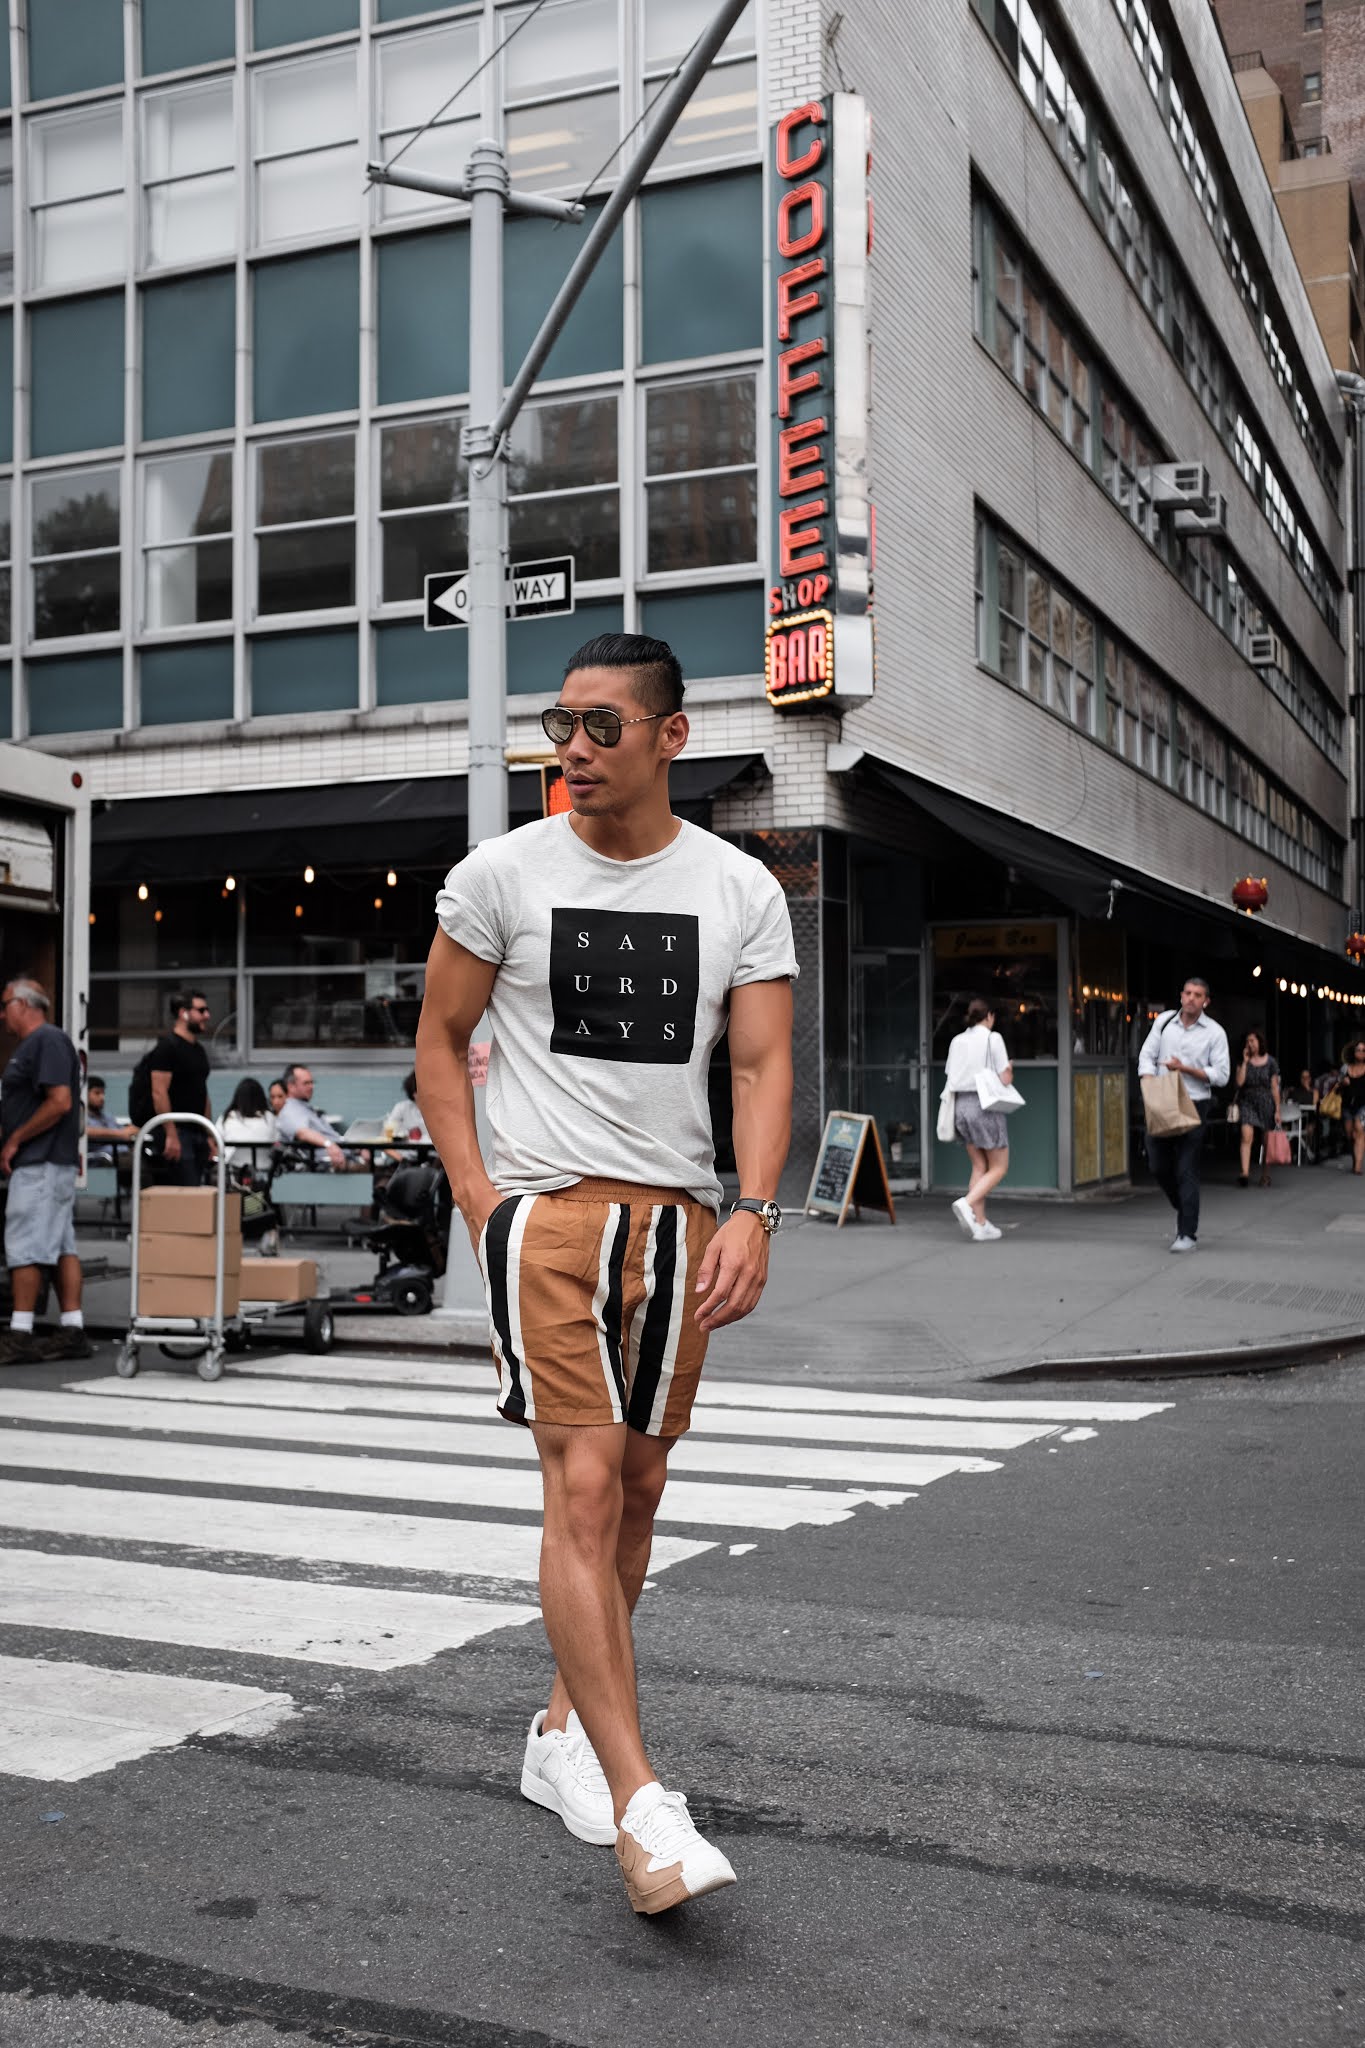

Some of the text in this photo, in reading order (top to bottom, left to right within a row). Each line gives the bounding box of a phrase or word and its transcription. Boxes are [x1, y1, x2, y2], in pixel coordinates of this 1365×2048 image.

[776, 101, 825, 577] COFFEE
[514, 577, 556, 601] WAY
[769, 574, 830, 615] SHOP
[770, 625, 827, 690] BAR
